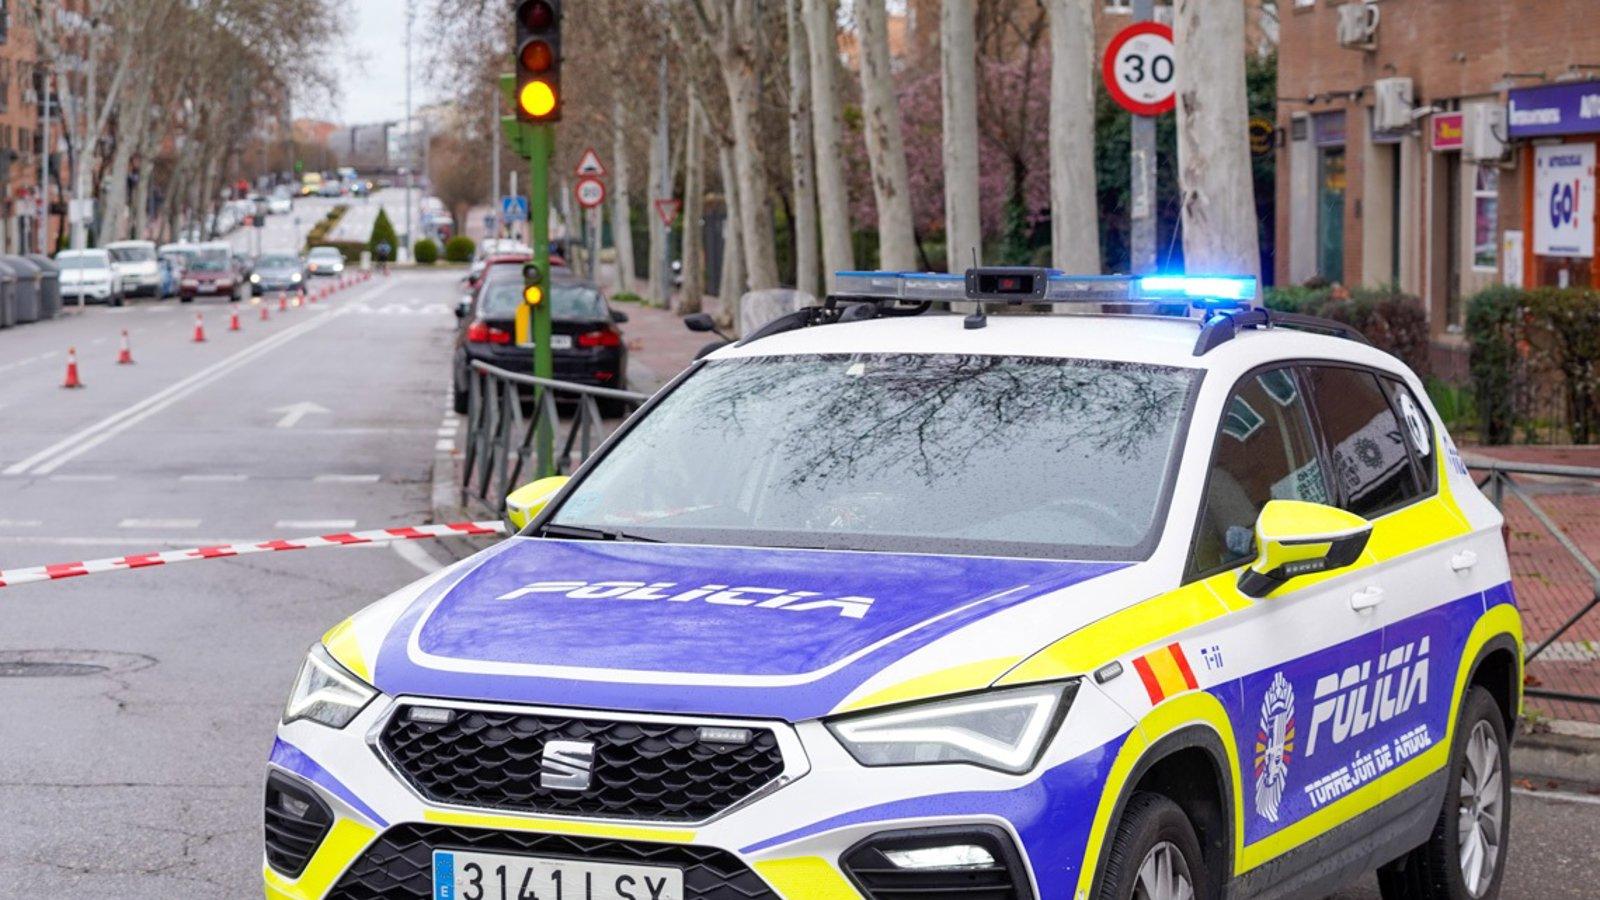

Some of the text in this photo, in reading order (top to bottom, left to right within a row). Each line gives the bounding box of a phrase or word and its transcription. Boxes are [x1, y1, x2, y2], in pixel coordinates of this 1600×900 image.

[1124, 54, 1174, 84] 30
[1551, 179, 1579, 229] GO!
[496, 581, 875, 619] POLICIA
[1305, 635, 1430, 757] POLICIA
[1373, 744, 1394, 773] DE
[1394, 723, 1432, 764] ARDOZ
[463, 862, 562, 900] 3141
